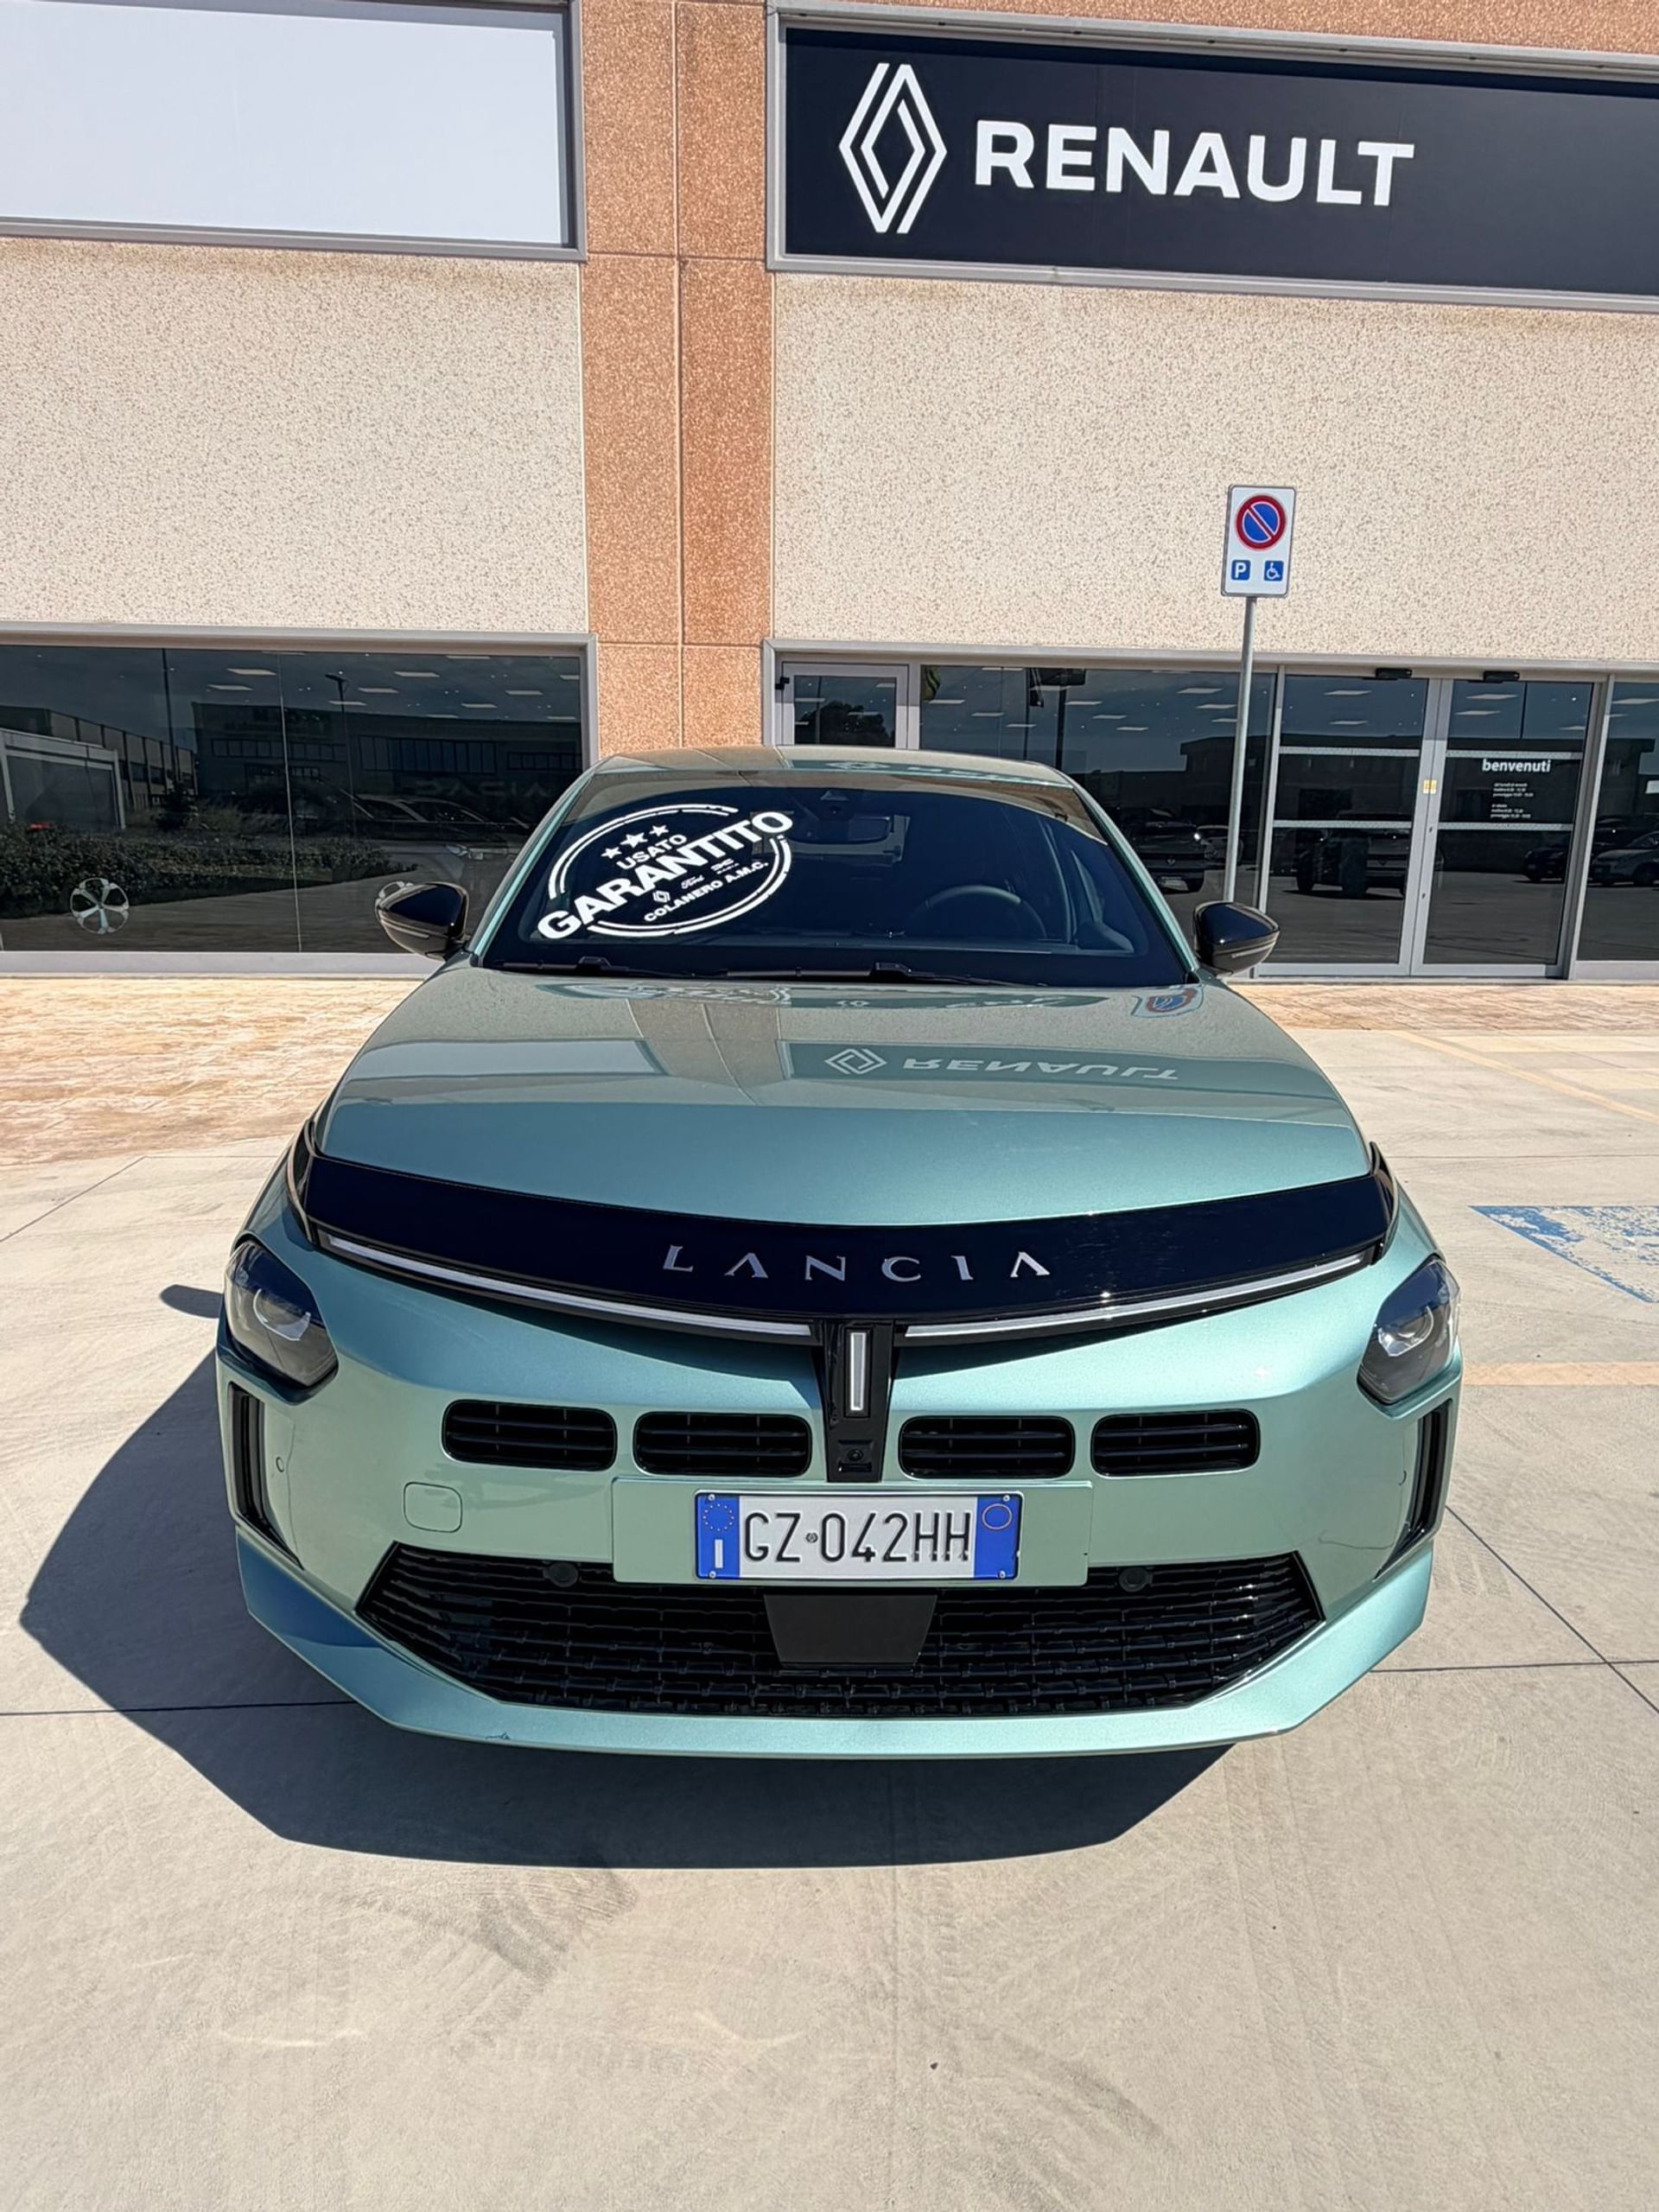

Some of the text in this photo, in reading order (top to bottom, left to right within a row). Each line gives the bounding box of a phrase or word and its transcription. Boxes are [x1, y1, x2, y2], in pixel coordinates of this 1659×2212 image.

[974, 119, 1415, 207] RENAULT
[1235, 562, 1247, 579] P
[1481, 759, 1552, 772] benvenuti
[615, 834, 688, 870] USATO
[537, 811, 794, 939] GARANTITO
[644, 861, 769, 922] COLANERO A.M.C.
[662, 1243, 1051, 1281] LANCIA
